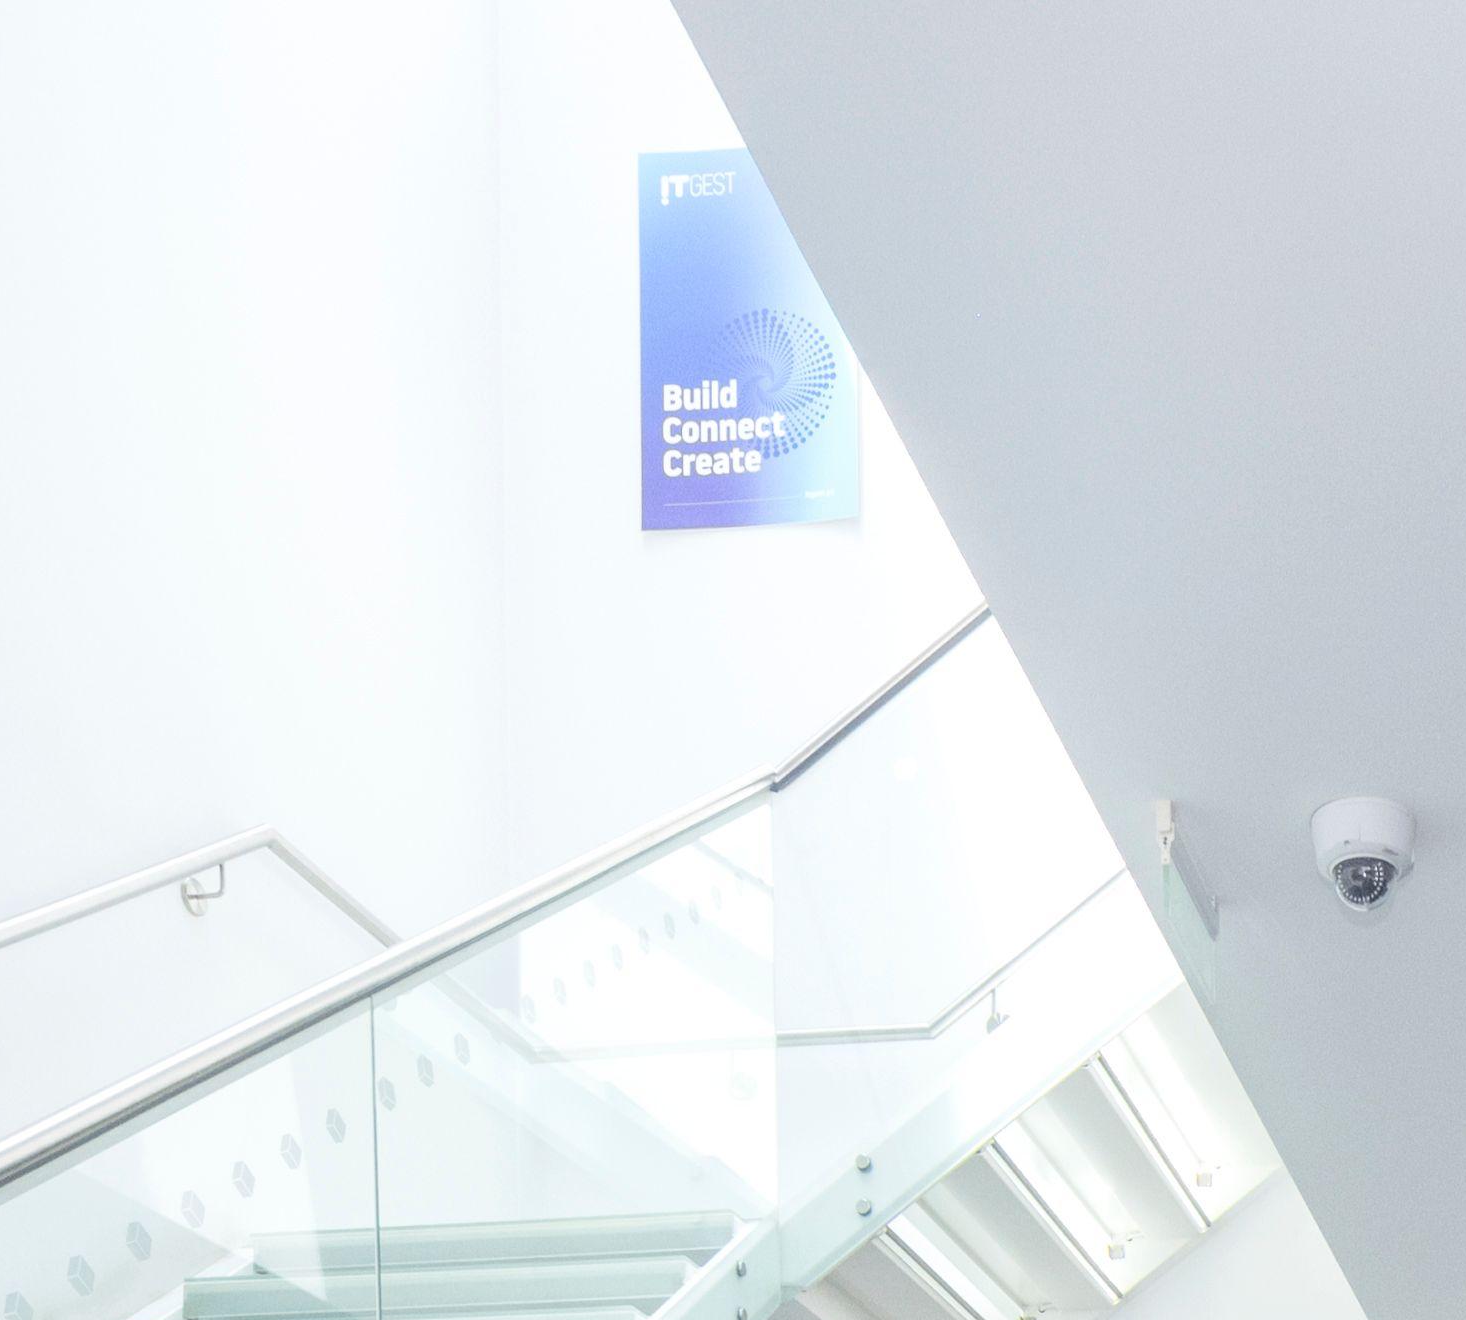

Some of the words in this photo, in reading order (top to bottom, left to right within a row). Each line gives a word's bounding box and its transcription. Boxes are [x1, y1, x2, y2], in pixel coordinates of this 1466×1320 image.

[663, 379, 737, 412] Build
[663, 411, 786, 444] Connect
[663, 447, 762, 477] Create
